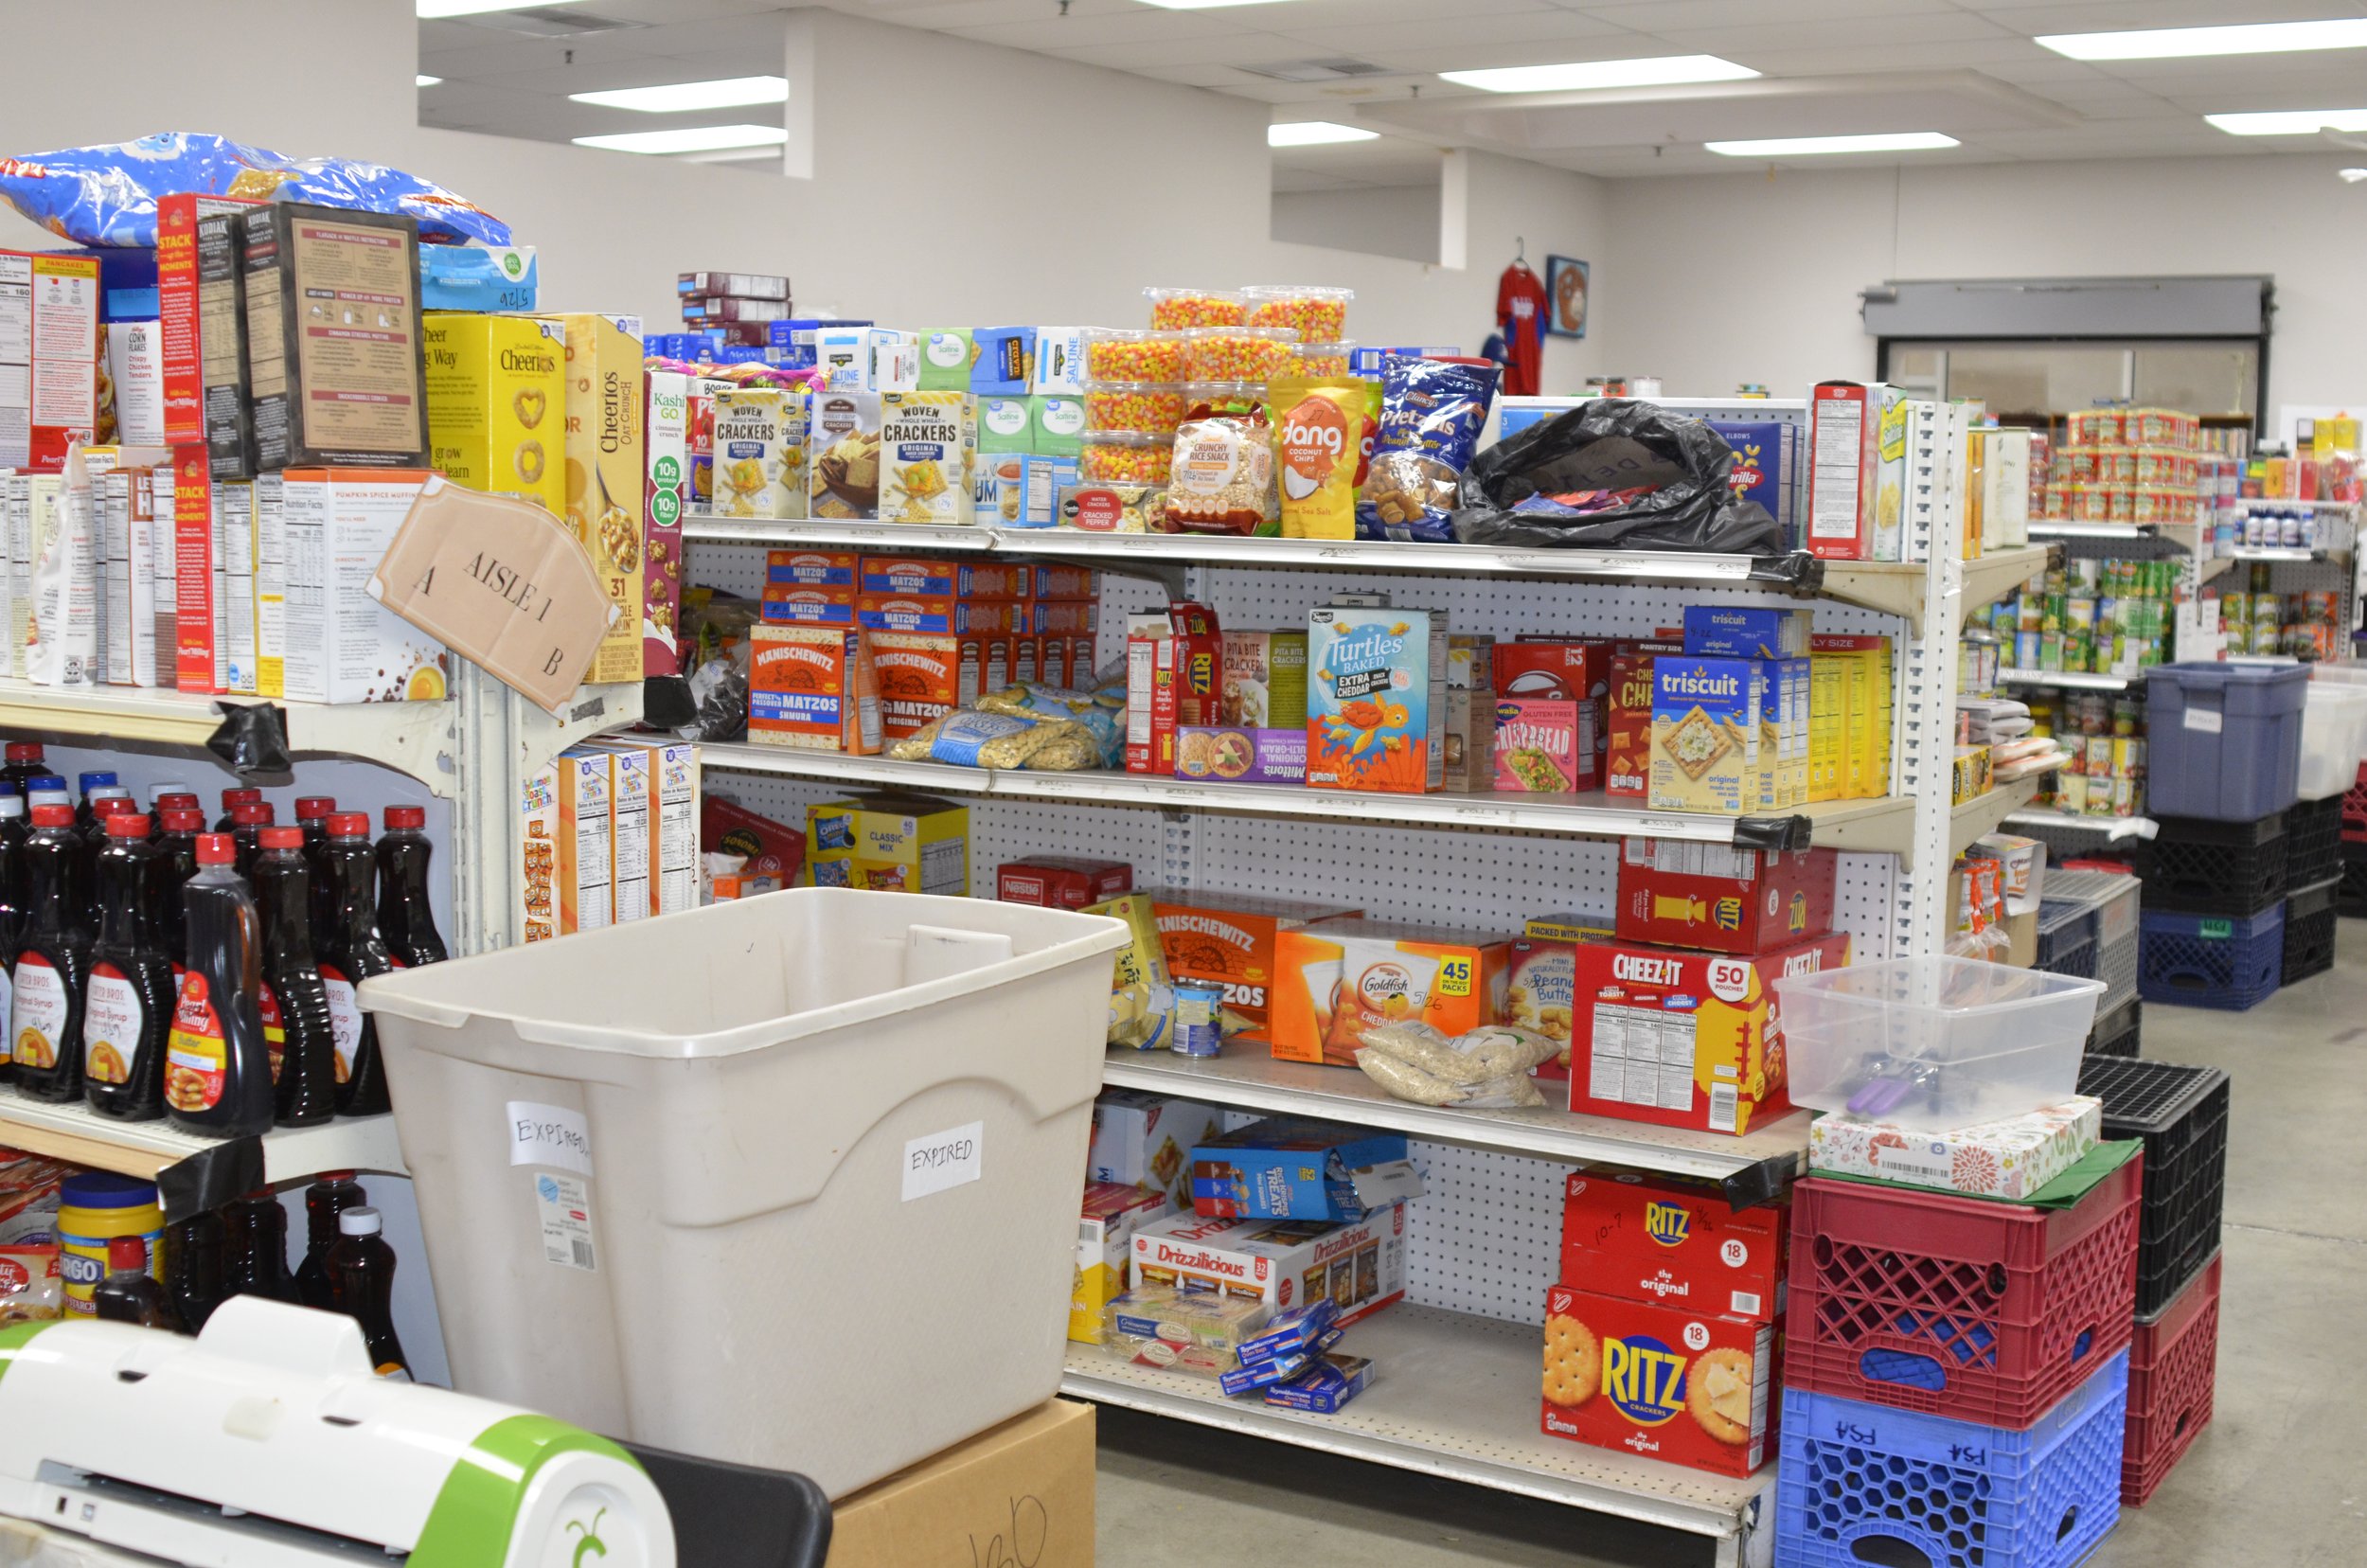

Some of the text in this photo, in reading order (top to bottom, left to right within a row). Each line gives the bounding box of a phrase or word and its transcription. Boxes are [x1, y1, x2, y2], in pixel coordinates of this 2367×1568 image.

[248, 211, 270, 227] KODIAK
[199, 221, 227, 238] KODIAK
[159, 234, 191, 249] STACK
[45, 259, 84, 269] PANCAKES
[160, 260, 192, 271] MOMENTS
[129, 333, 146, 343] CORN
[129, 343, 147, 352] FLAKES
[434, 349, 457, 369] Way
[501, 349, 555, 372] Cheerios
[1066, 336, 1078, 383] SALTINE
[654, 393, 685, 408] Kashi
[1405, 391, 1439, 407] Clancy's
[600, 371, 618, 454] Cheerios
[621, 381, 632, 445] OAT CRUNCH
[661, 408, 679, 419] GO
[733, 406, 762, 418] WOVEN
[901, 407, 939, 418] WOVEN
[718, 424, 774, 440] CRACKERS
[884, 424, 956, 441] CRACKERS
[1283, 419, 1342, 455] dang
[696, 436, 707, 447] 10
[1194, 443, 1228, 452] CRUNCHY
[436, 446, 462, 462] grow
[1190, 452, 1230, 461] RICE SNACK
[658, 463, 676, 477] 10g
[175, 487, 205, 500] STACK
[286, 501, 311, 509] Nutrition
[657, 498, 676, 511] 10g
[790, 554, 830, 567] MANISCHEWITZ
[793, 567, 827, 578] MATZOS
[413, 565, 436, 597] A
[463, 551, 538, 612] AISLE
[611, 579, 626, 597] 31
[890, 576, 925, 587] MATZOS
[786, 591, 829, 604] MANISCHEWITZ
[790, 603, 825, 614] MATZOS
[881, 600, 924, 614] MANISCHEWITZ
[884, 614, 920, 624] MATZOS
[1712, 615, 1746, 626] triscuit
[1227, 643, 1261, 656] PITA BITE
[1329, 633, 1404, 667] Turtles
[1705, 641, 1733, 650] original
[542, 647, 563, 676] B
[756, 647, 835, 672] MANISCHEWITZ
[875, 652, 947, 679] ANISCHEWITZ
[1224, 658, 1263, 672] CRACKERS
[1344, 656, 1385, 674] BAKED
[1156, 670, 1172, 684] RITZ
[1194, 653, 1212, 695] RITZ
[1339, 672, 1370, 686] EXTRA
[1337, 684, 1370, 698] CHEDDAR
[1662, 672, 1739, 696] triscuit
[752, 699, 782, 707] PASSOVER
[782, 695, 838, 712] MATZOS
[779, 711, 811, 722] SHMURA
[887, 717, 922, 727] ORIGINAL
[1266, 755, 1307, 763] ORIGINAL
[1263, 765, 1306, 777] Milton's
[1708, 775, 1739, 784] original
[870, 831, 903, 843] CLASSIC
[879, 843, 893, 852] MIX
[1719, 896, 1742, 931] RITZ
[1157, 917, 1255, 952] ANISCHEWITZ
[1443, 962, 1468, 979] 45
[1716, 966, 1744, 984] 50
[1364, 977, 1409, 993] Goldfish
[1442, 983, 1468, 992] PACKS
[1414, 991, 1443, 1010] 5/26
[1598, 990, 1626, 999] TOASTY
[180, 995, 205, 1013] Pearl
[1667, 999, 1693, 1007] CHEESY
[177, 1008, 209, 1032] Milling
[177, 1035, 201, 1048] Butter
[517, 1120, 586, 1155] EXPIRED
[912, 1139, 972, 1171] EXPIRED
[1266, 1168, 1282, 1216] TREATS
[1646, 1202, 1690, 1239] RITZ
[1313, 1226, 1370, 1263] Drizzilicious
[1726, 1244, 1741, 1257] 18
[1157, 1244, 1245, 1278] Drizzilicious
[1256, 1261, 1267, 1272] 32
[1659, 1270, 1672, 1280] the
[1641, 1277, 1689, 1297] original
[1686, 1327, 1703, 1340] 18
[1242, 1350, 1255, 1359] Oven
[1601, 1336, 1688, 1412] RITZ
[1629, 1403, 1666, 1417] CRACKERS
[1625, 1436, 1659, 1452] original
